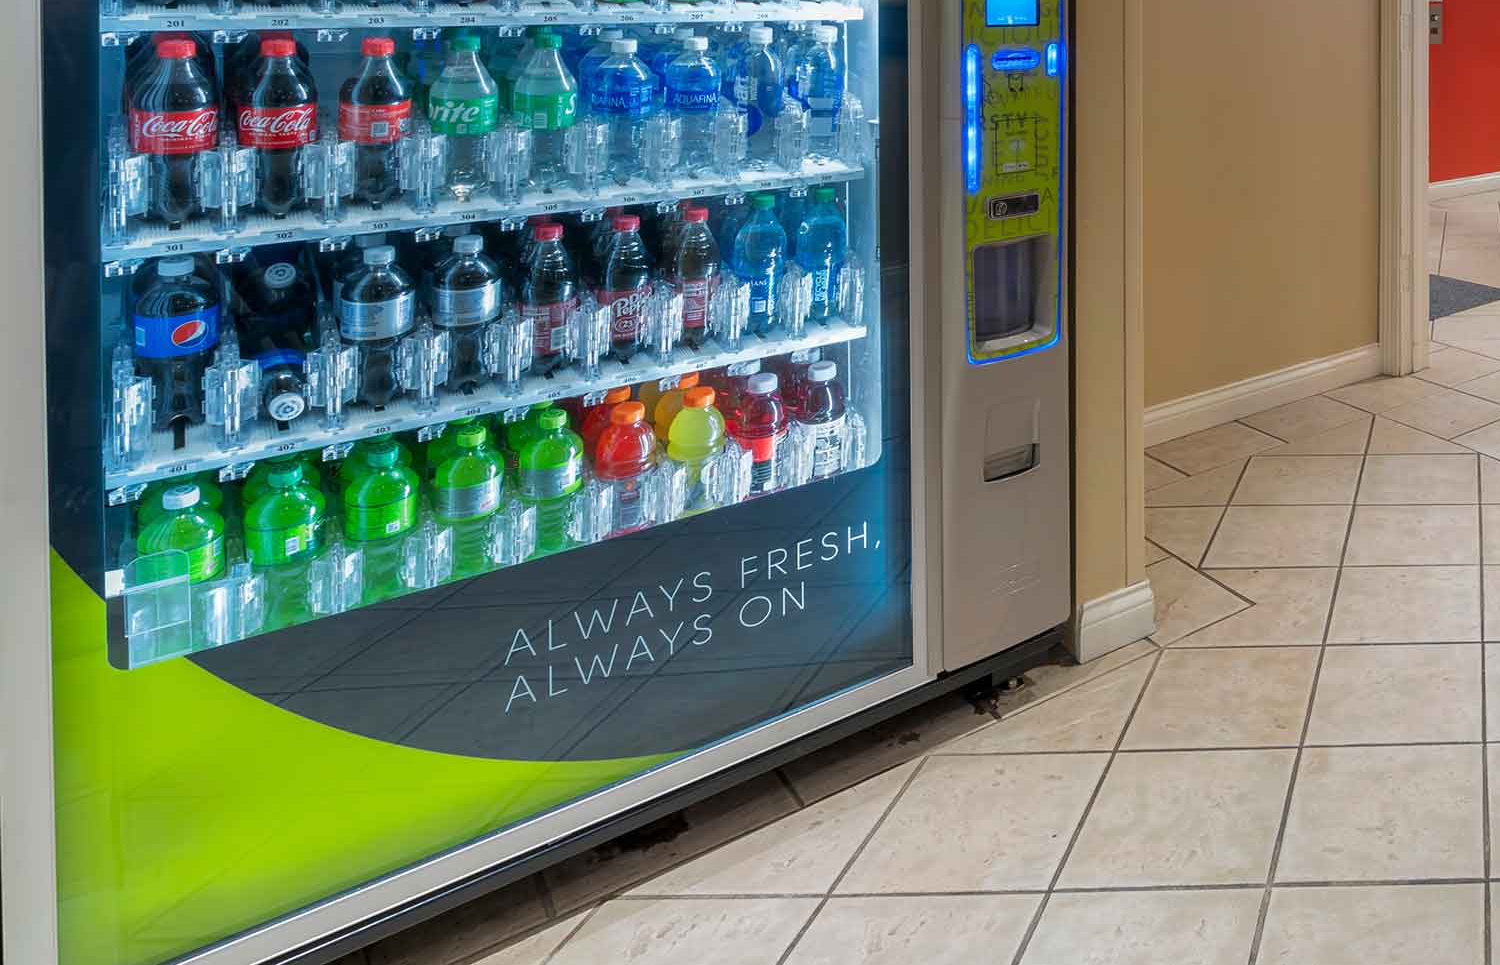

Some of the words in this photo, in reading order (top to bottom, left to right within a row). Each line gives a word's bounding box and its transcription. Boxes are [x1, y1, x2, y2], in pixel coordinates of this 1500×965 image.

[167, 19, 185, 27] 201
[143, 110, 218, 137] Coca-Cola
[239, 107, 314, 133] Coca-Cola
[430, 101, 480, 123] rite
[166, 243, 184, 252] 301
[504, 571, 713, 666] ALWAYS
[741, 520, 881, 589] FRESH,
[504, 614, 713, 713] ALWAYS
[739, 581, 805, 628] ON
